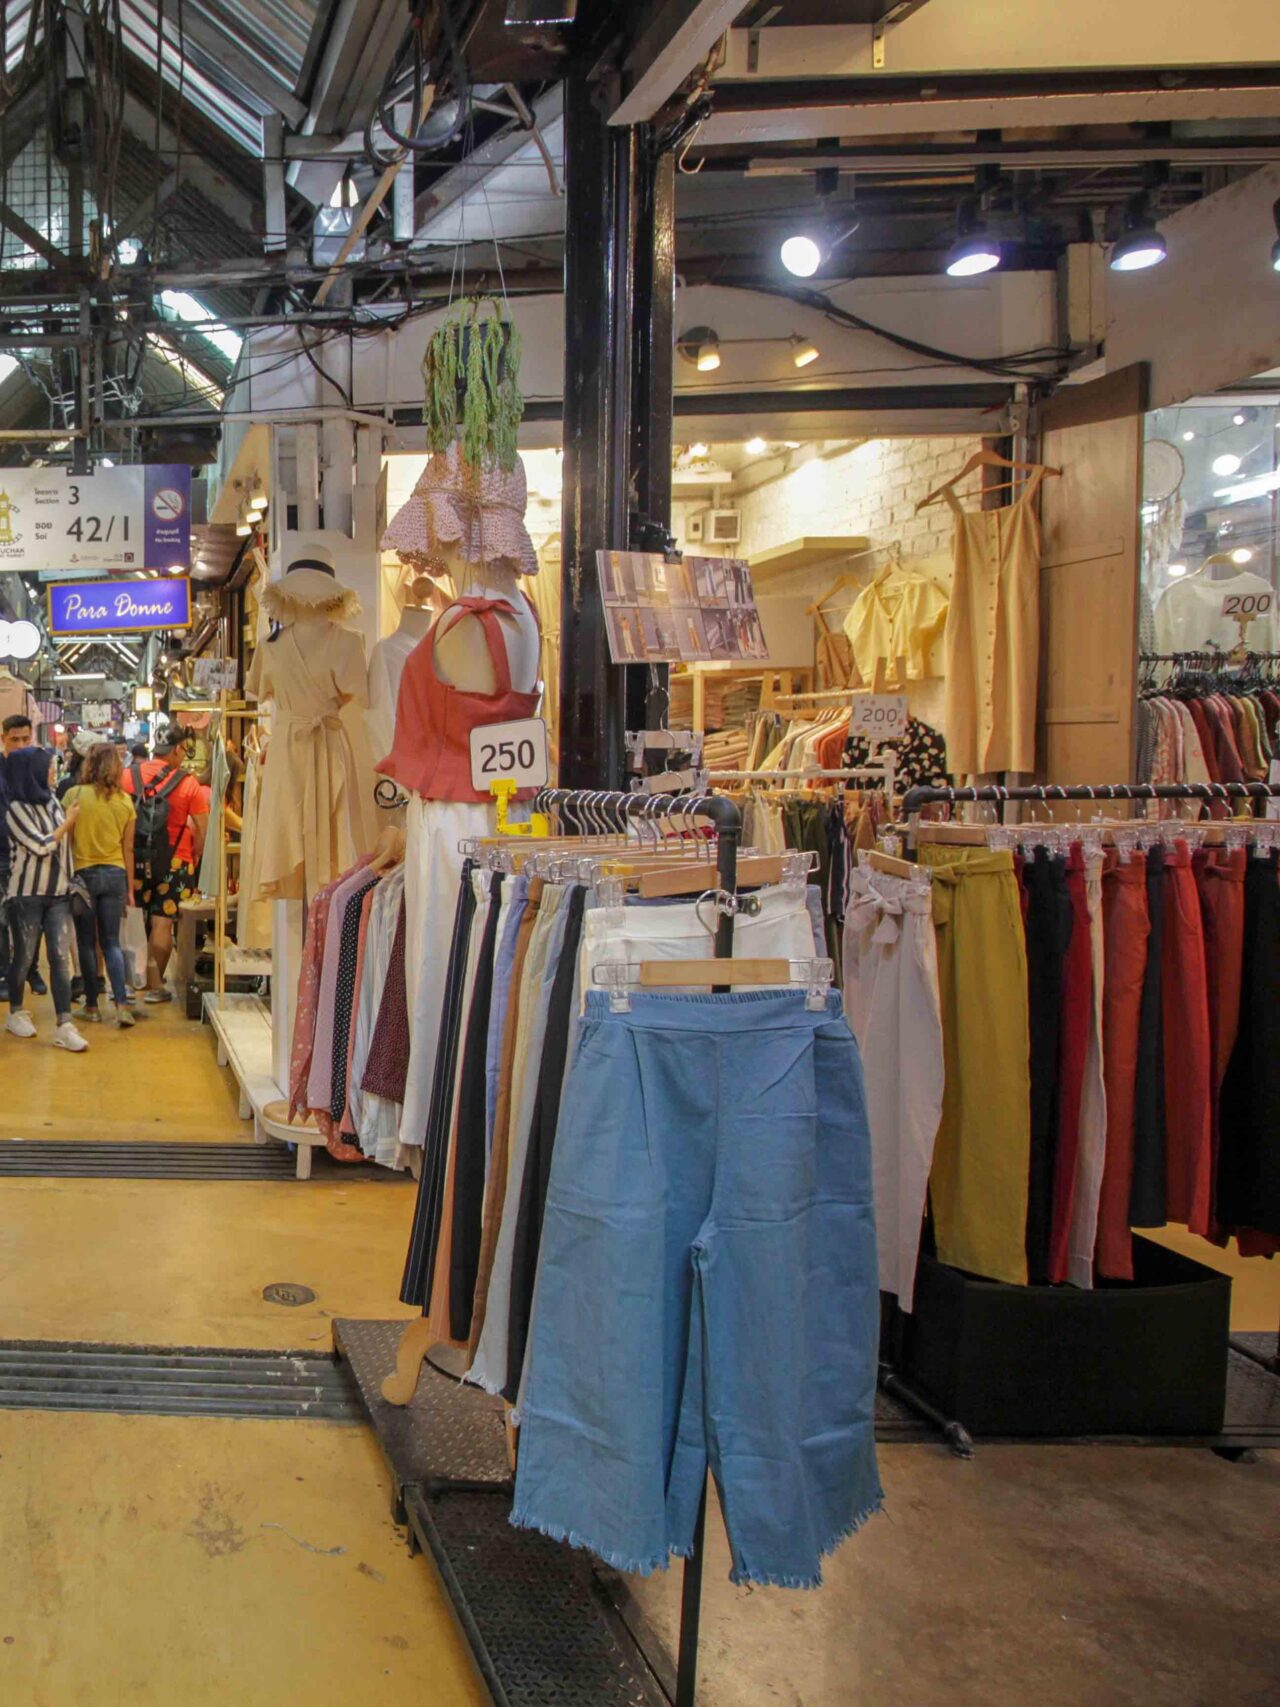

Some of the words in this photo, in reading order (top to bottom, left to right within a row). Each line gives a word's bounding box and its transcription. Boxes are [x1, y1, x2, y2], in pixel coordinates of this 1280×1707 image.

[68, 485, 80, 505] 3
[35, 532, 48, 540] Soi
[66, 515, 129, 543] 42/1
[63, 593, 109, 620] Para
[1225, 594, 1271, 615] 200
[861, 708, 898, 722] 200
[480, 738, 536, 774] 250
